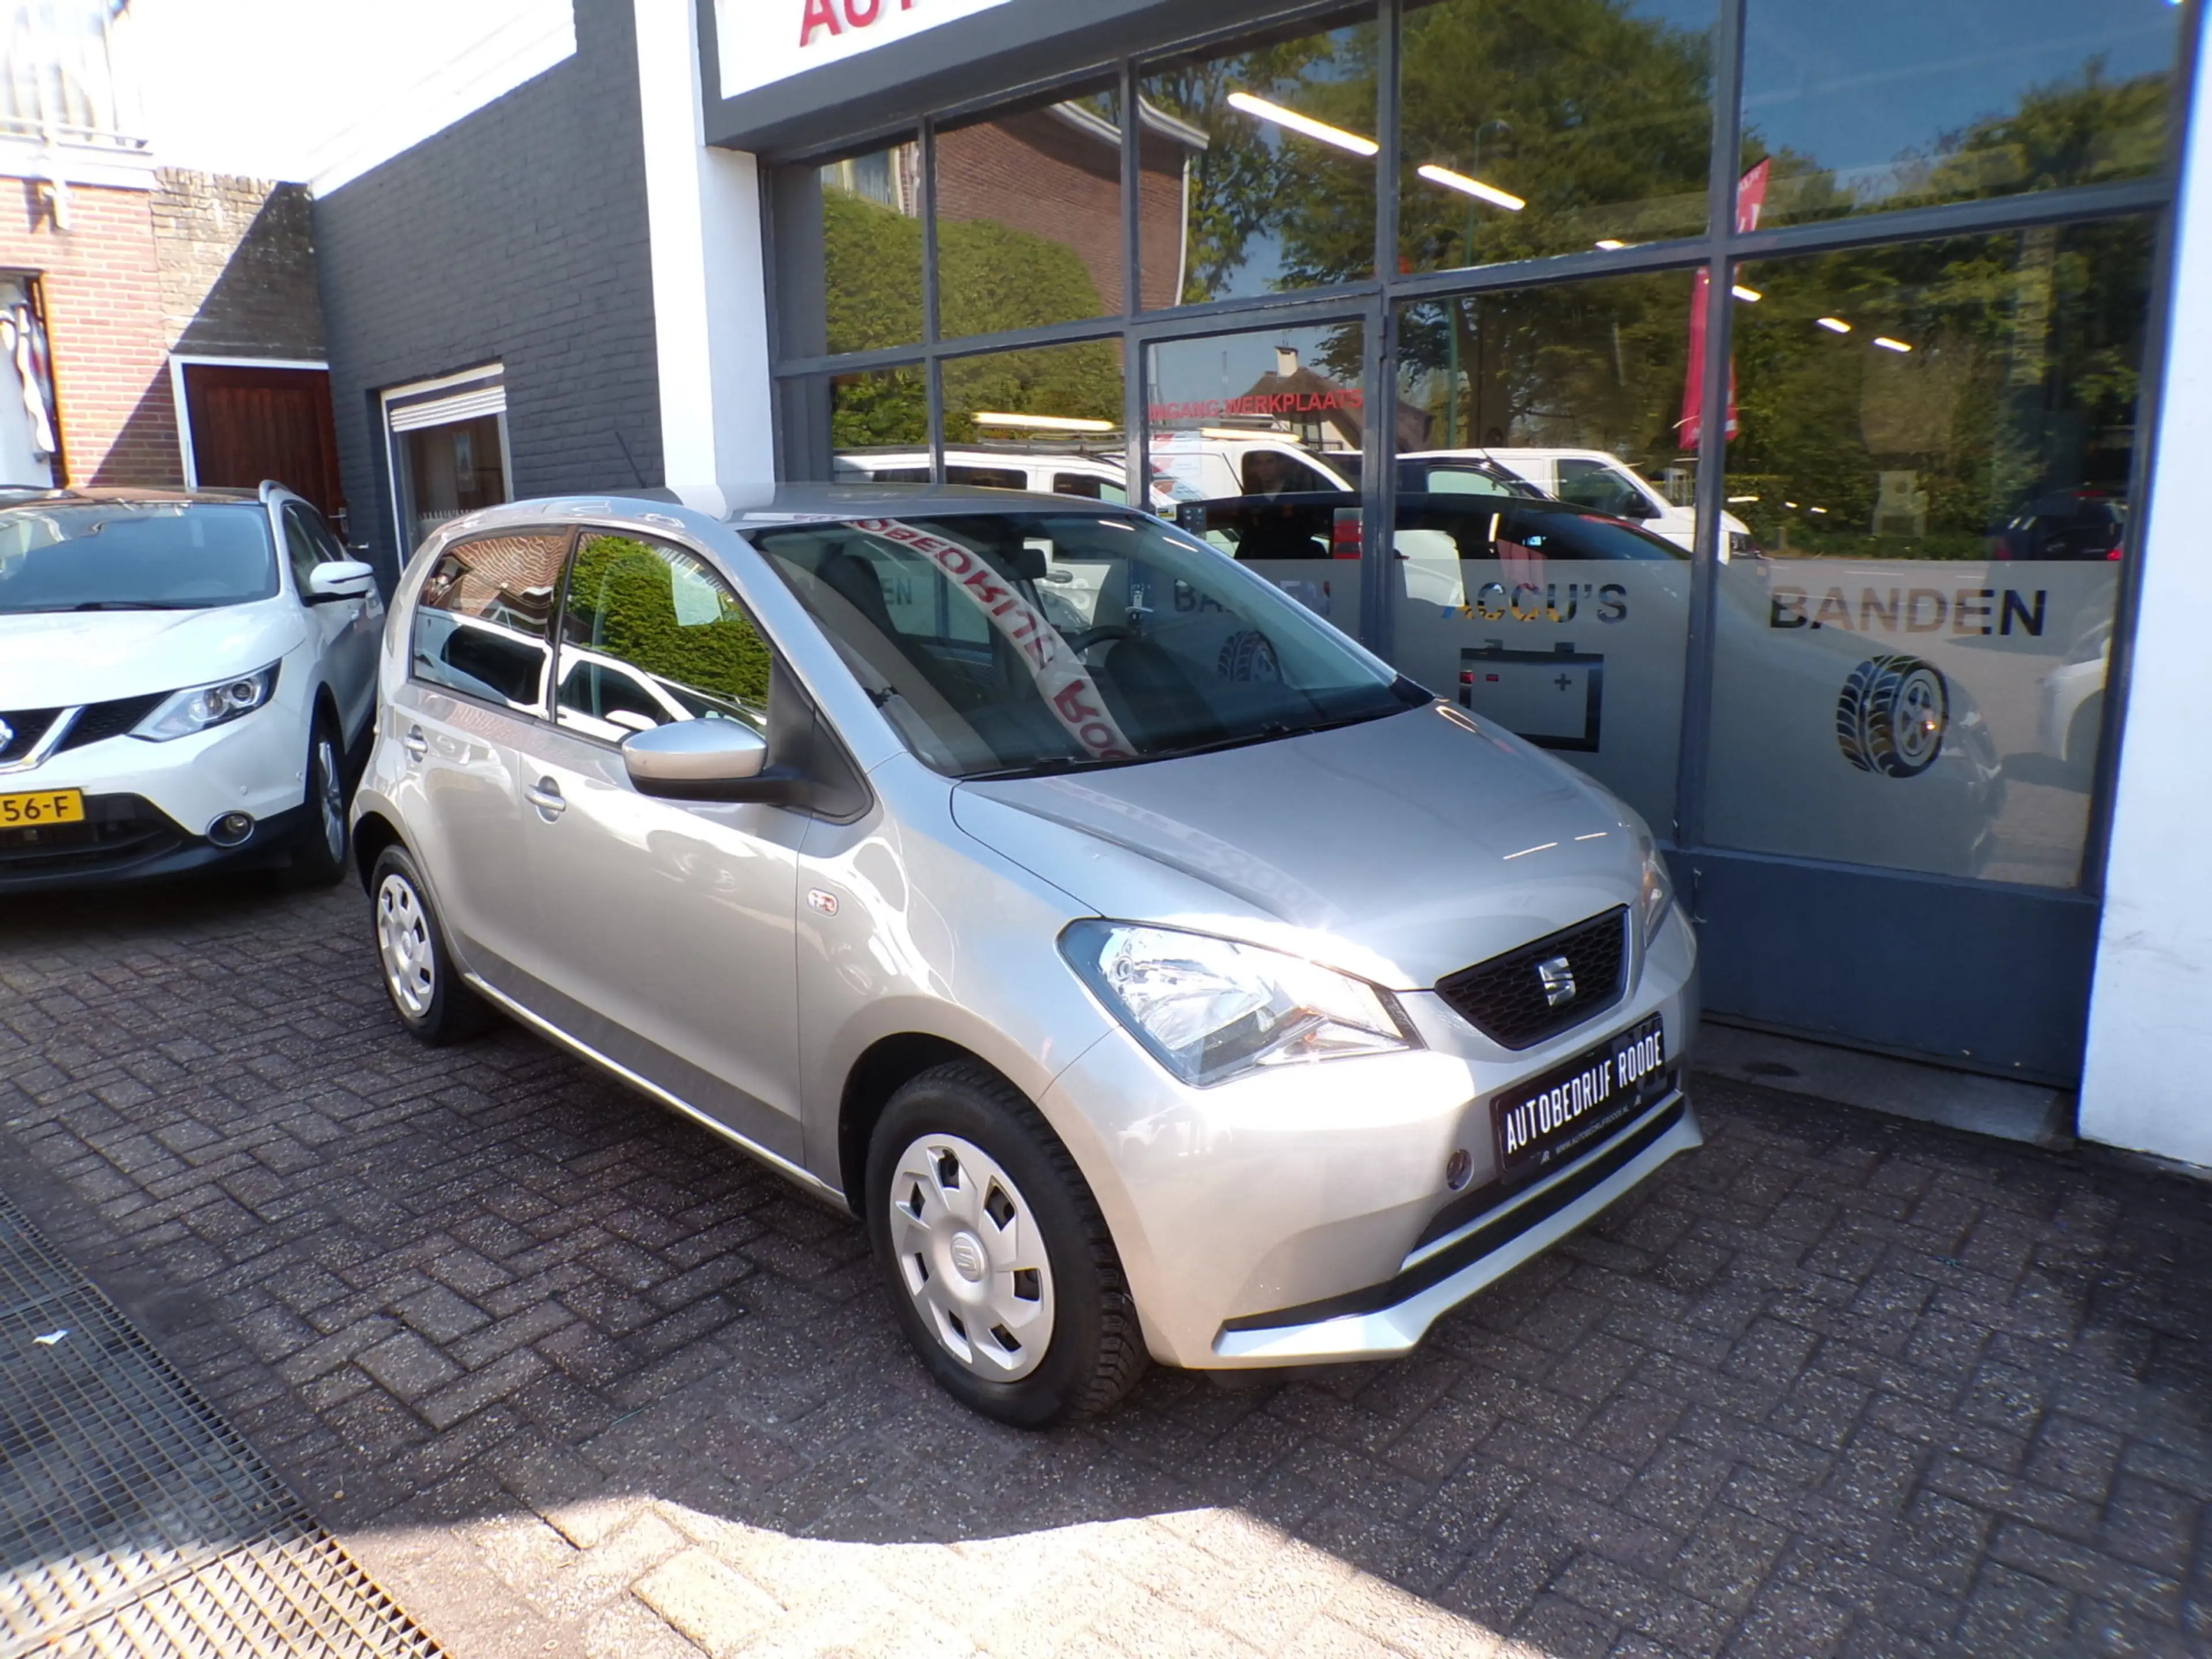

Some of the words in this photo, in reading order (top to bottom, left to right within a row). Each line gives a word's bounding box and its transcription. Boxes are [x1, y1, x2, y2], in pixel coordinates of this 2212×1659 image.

[1225, 388, 1363, 415] WERKPLAATS
[1442, 582, 1628, 624] ACCU'S
[1770, 586, 2047, 636] BANDEN
[3, 796, 69, 822] 56-F
[1507, 1059, 1612, 1154] AUTOBEDRIJF
[1618, 1031, 1663, 1089] ROODE
